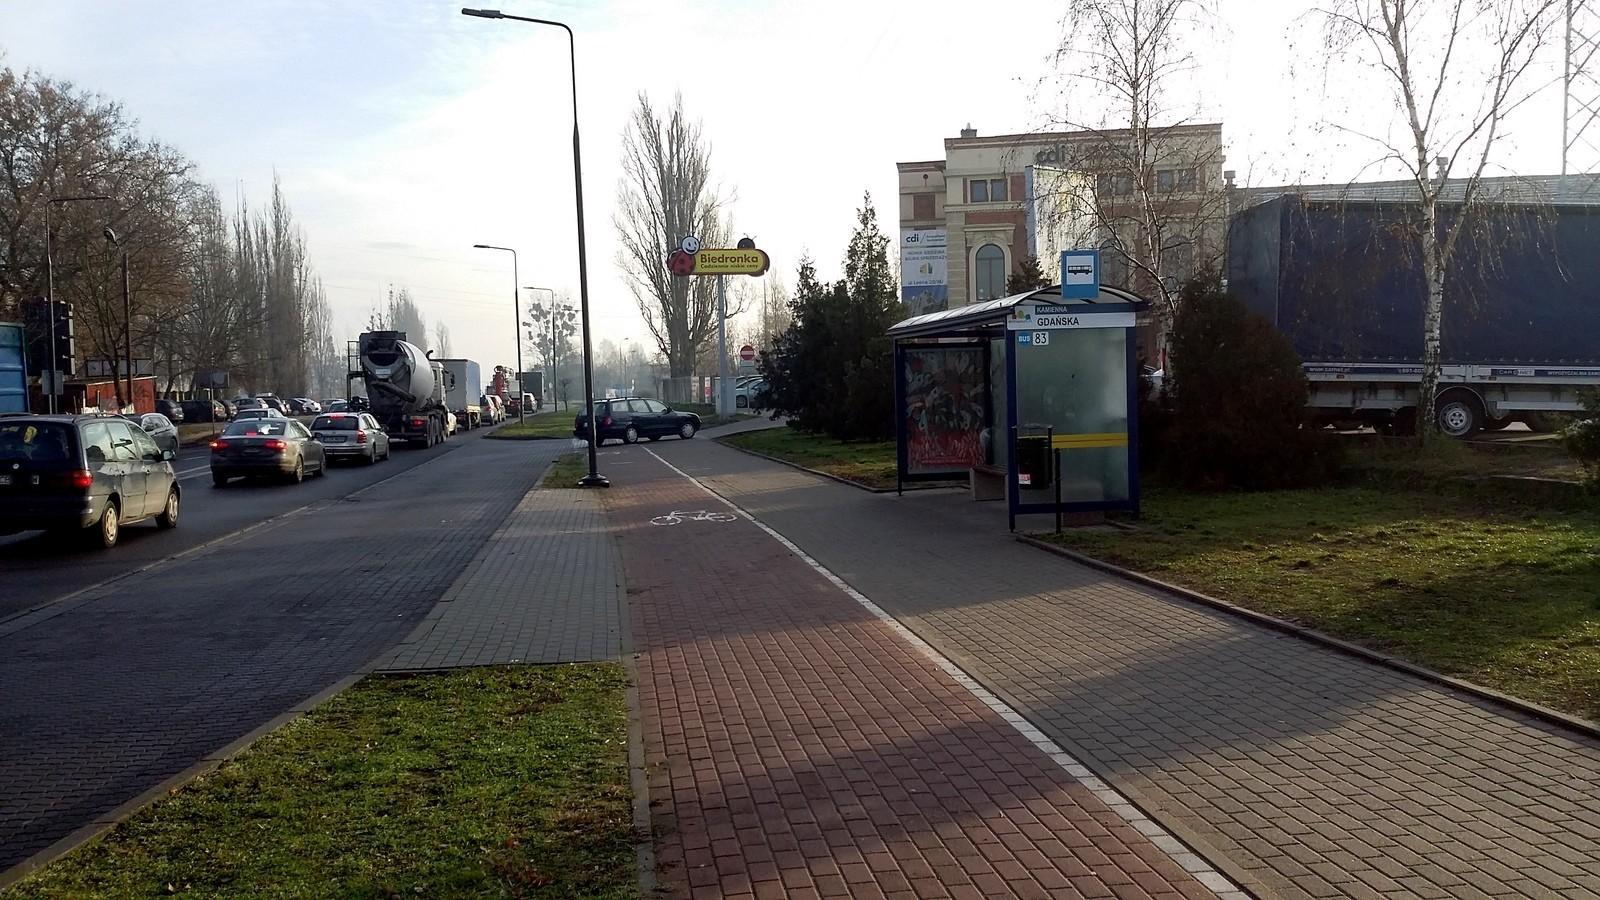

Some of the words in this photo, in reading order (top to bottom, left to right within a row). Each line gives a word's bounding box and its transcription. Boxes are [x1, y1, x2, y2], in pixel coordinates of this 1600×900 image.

[905, 233, 919, 243] cdi
[700, 253, 758, 263] Biedronka
[1037, 315, 1080, 327] GDAŃSKA
[1034, 332, 1047, 344] 83
